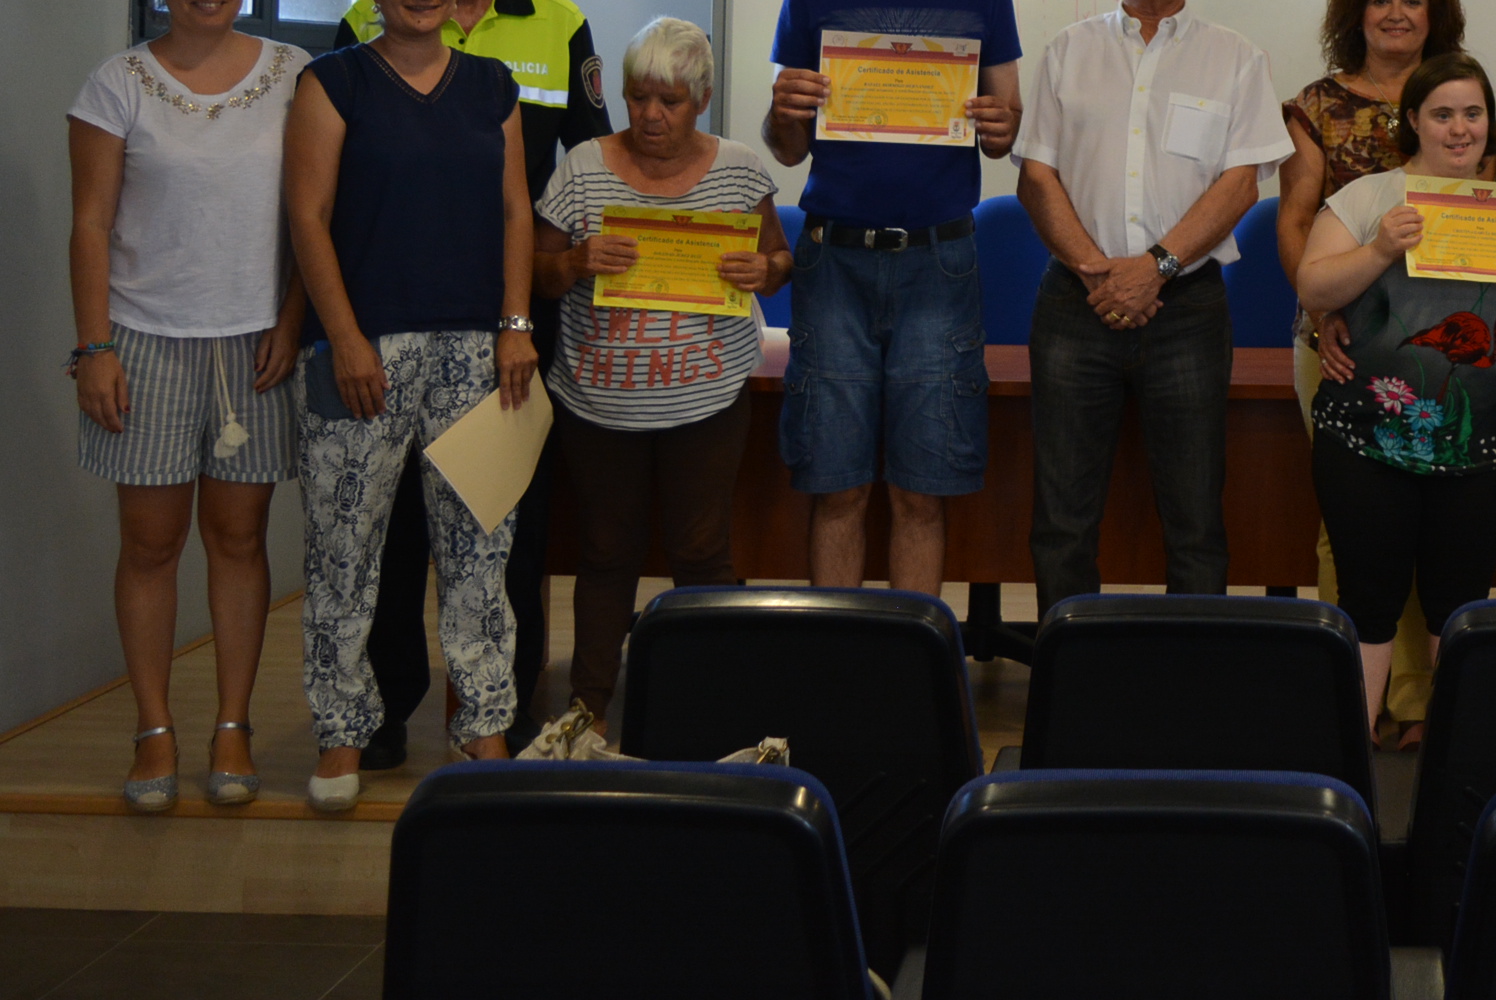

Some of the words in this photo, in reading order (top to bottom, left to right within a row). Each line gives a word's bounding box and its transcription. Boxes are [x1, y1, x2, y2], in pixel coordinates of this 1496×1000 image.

[505, 61, 547, 75] OLICIA
[857, 66, 895, 75] Certificado
[905, 69, 941, 77] Asistencia
[1441, 212, 1476, 221] Certificado
[637, 235, 674, 244] Certificado
[686, 239, 720, 248] Asistencia
[574, 340, 724, 388] THINGS
